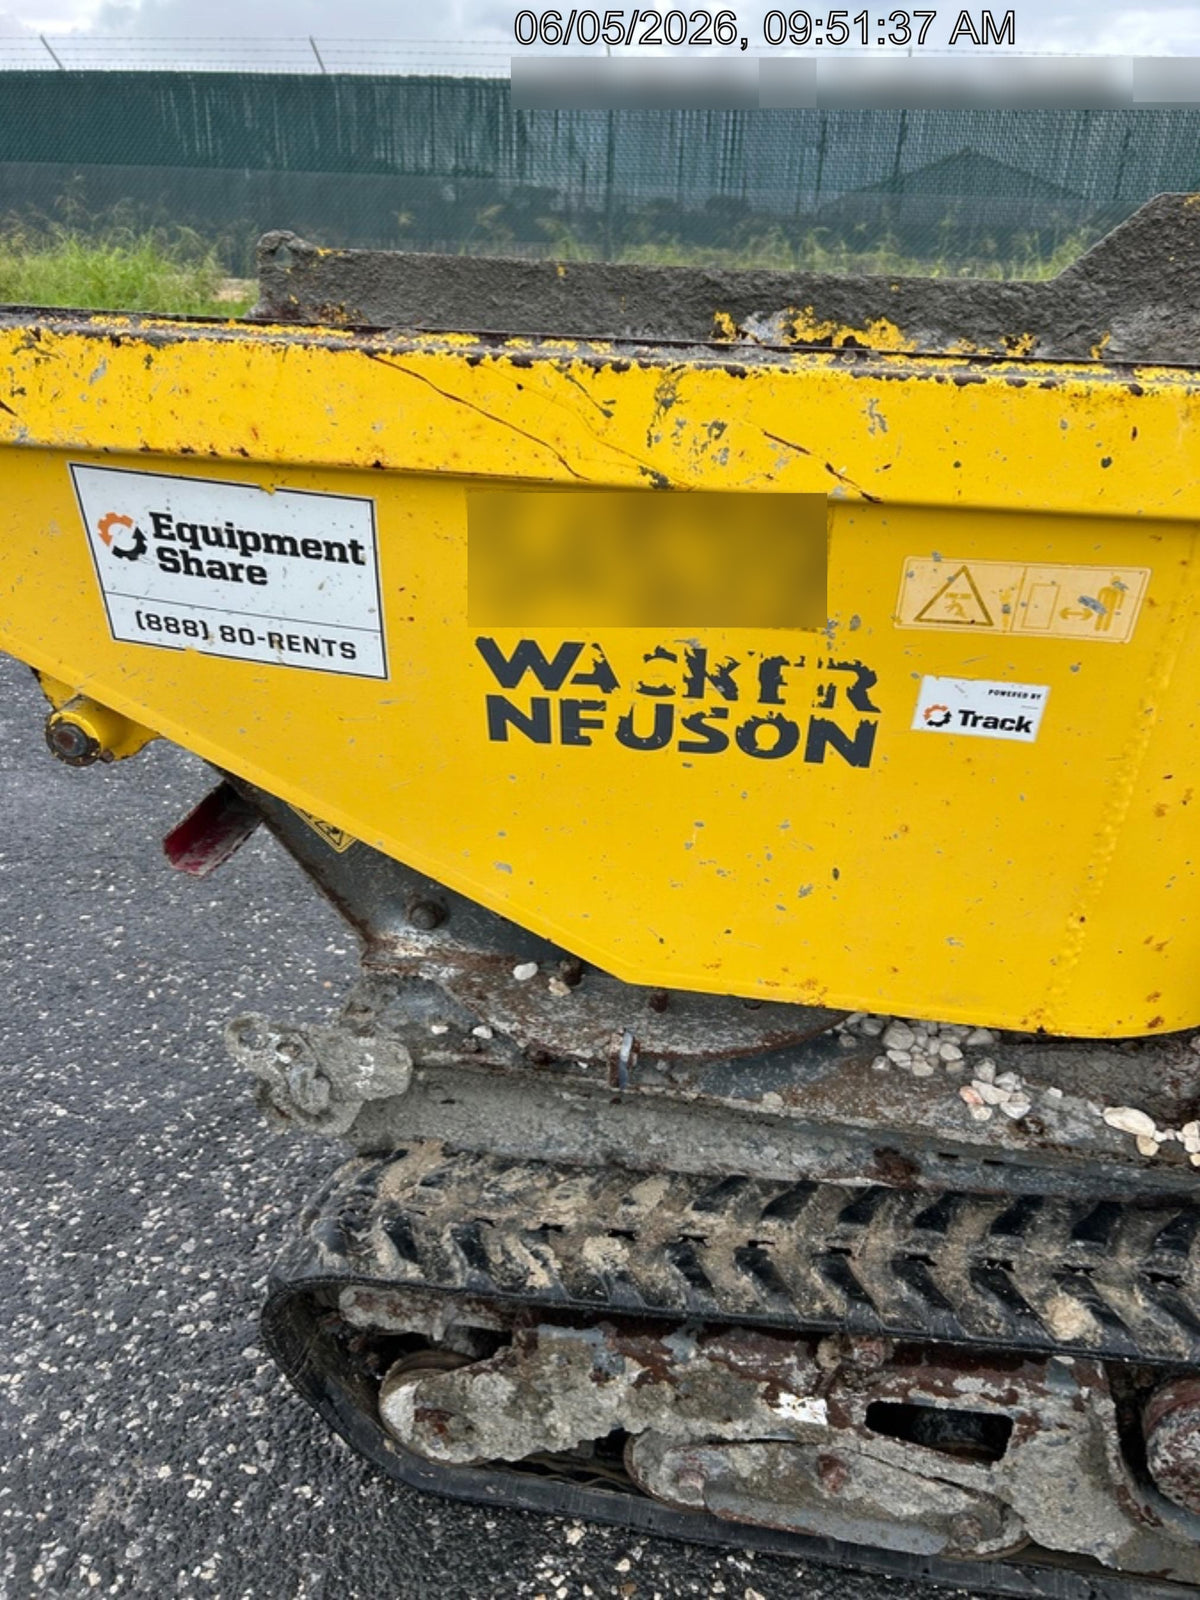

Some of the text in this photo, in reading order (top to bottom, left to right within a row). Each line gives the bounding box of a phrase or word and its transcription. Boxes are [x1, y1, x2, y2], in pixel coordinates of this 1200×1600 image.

[149, 511, 366, 566] Equipment
[155, 546, 268, 586] Share
[135, 610, 357, 660] (888) 80-RENTS
[987, 688, 1028, 699] POWERED
[486, 694, 879, 769] NEUSON
[957, 708, 1033, 733] Track
